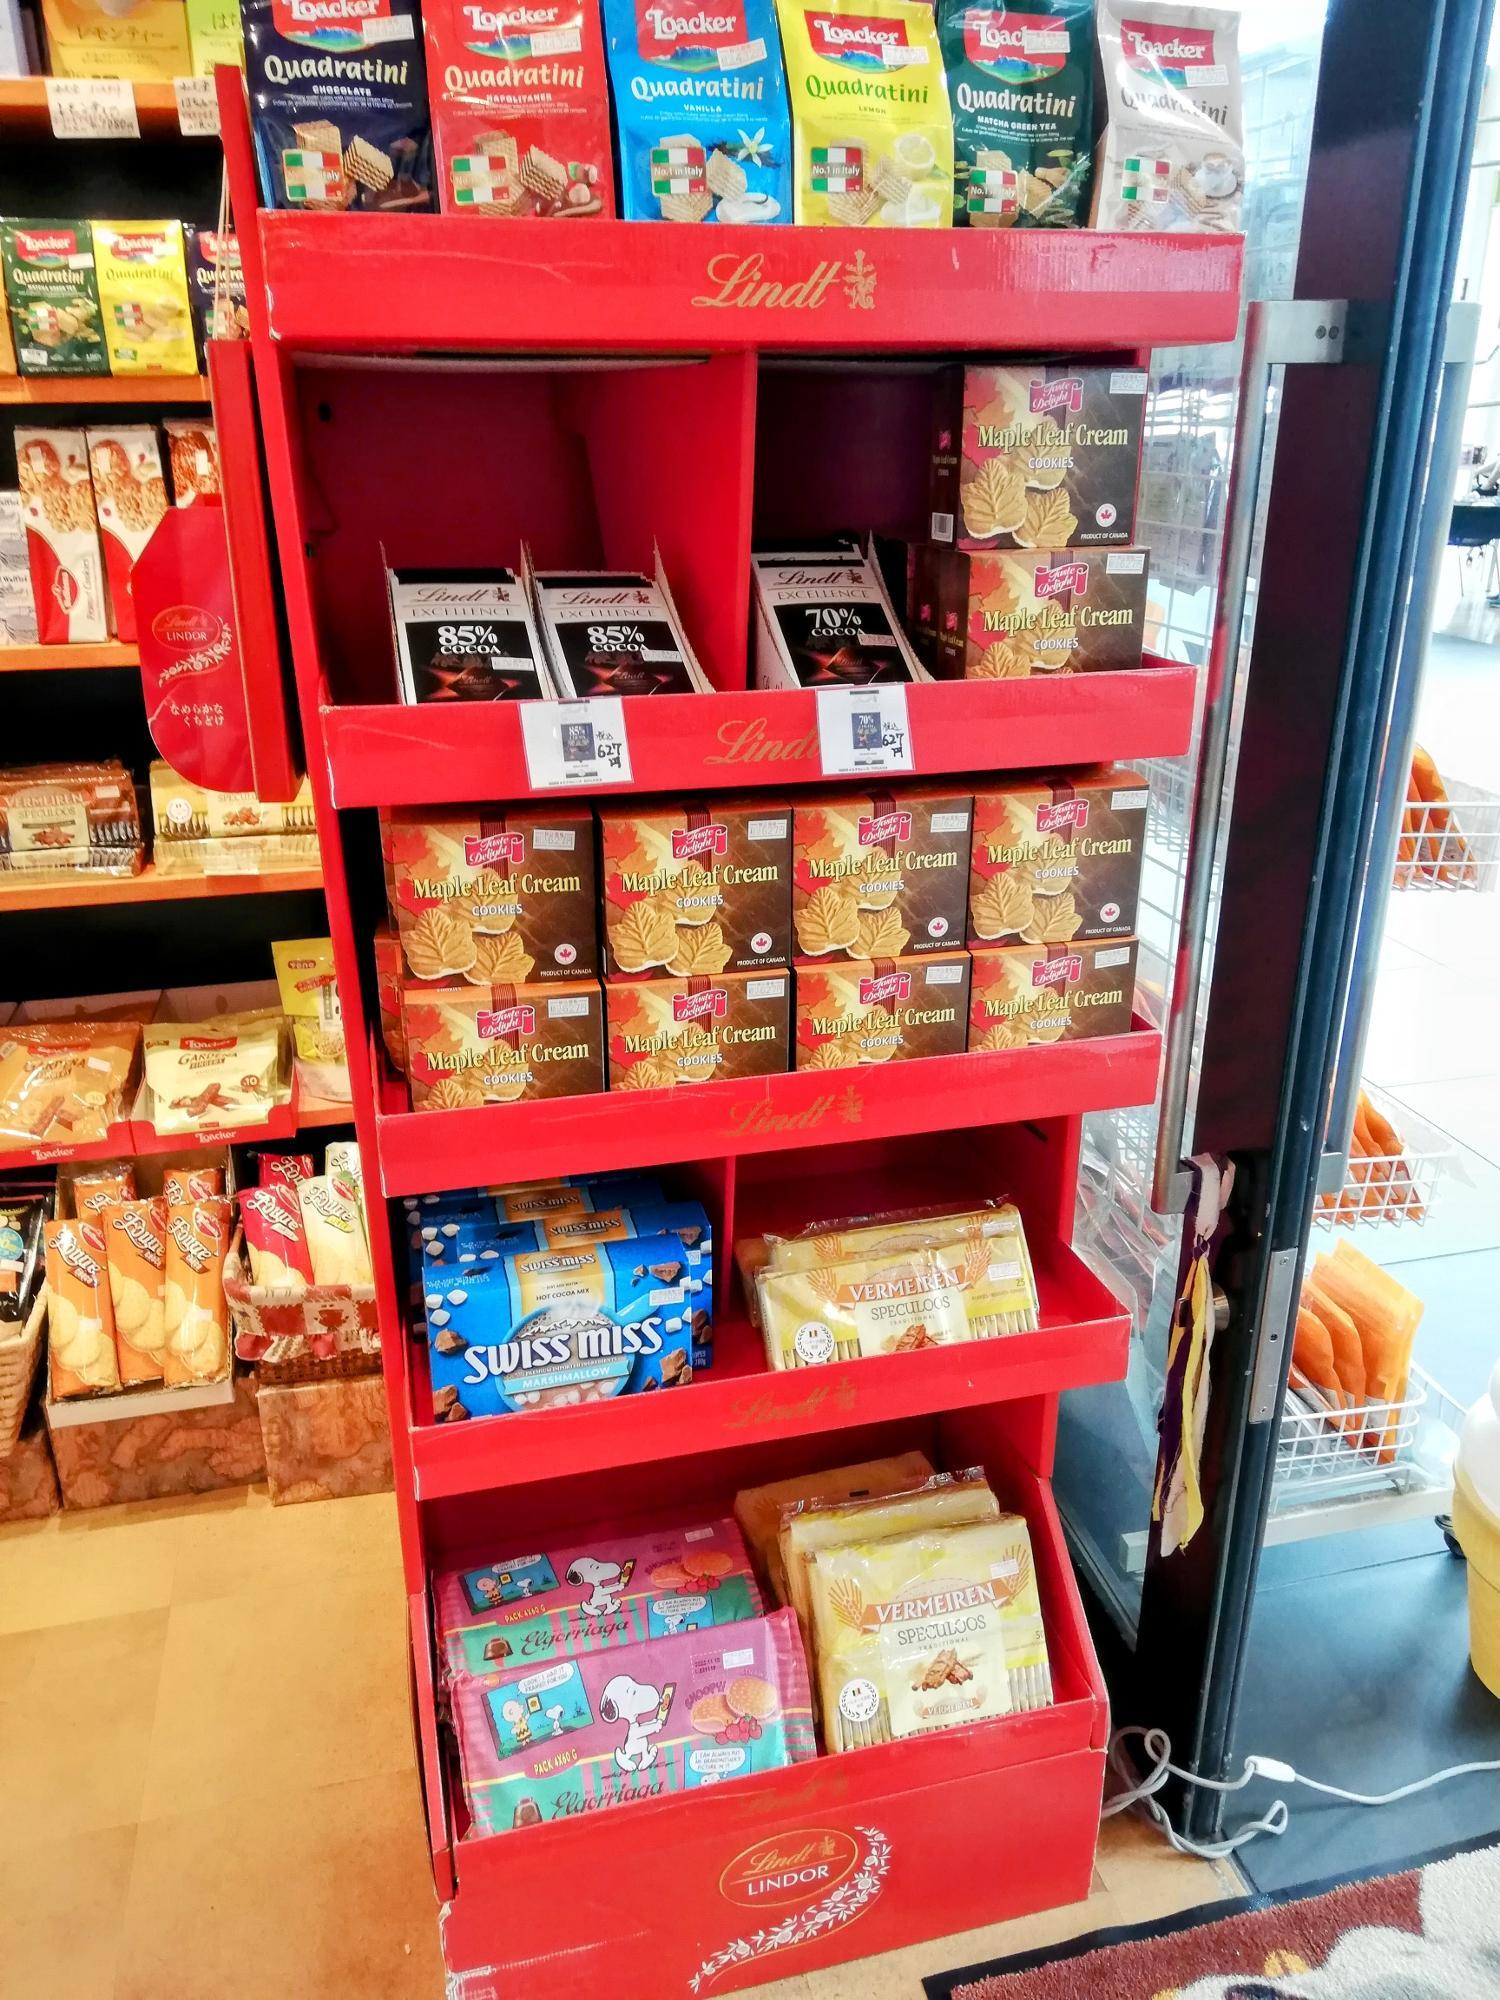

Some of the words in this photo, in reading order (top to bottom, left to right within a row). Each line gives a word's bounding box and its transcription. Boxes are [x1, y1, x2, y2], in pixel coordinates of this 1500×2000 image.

[291, 0, 379, 22] Loacker
[463, 5, 559, 32] Loacker
[645, 7, 737, 40] Loacker
[814, 19, 900, 46] Loacker
[1128, 31, 1207, 60] Loacker
[263, 55, 409, 86] Quadratini
[444, 64, 585, 93] Quadratini
[311, 84, 372, 97] CHOCOLATE
[630, 76, 765, 102] Quadratini
[805, 74, 930, 105] Quadratini
[683, 103, 723, 114] VANILLA
[956, 82, 1077, 119] Quadratini
[977, 115, 1010, 129] MATCHA
[1010, 122, 1038, 131] GREEN
[1040, 122, 1057, 131] TEA
[684, 165, 704, 178] Italy
[842, 164, 861, 179] Italy
[12, 267, 85, 286] Quadratini
[691, 252, 842, 310] Lindt
[1032, 391, 1070, 412] Delight
[978, 424, 1033, 453] Maple
[1035, 423, 1074, 447] Leaf
[1076, 425, 1129, 446] Cream
[1028, 456, 1074, 469] COOKIES
[1109, 532, 1129, 540] CANADA
[774, 570, 844, 586] Lindt
[1037, 577, 1074, 597] Delight
[411, 586, 490, 604] Lindt
[556, 590, 631, 606] Lindt
[777, 589, 869, 600] EXCELLENCE
[411, 607, 512, 618] EXCELLENCE
[560, 608, 654, 618] EXCELLENCE
[805, 608, 862, 629] 70%
[983, 610, 1036, 637] Maple
[1039, 609, 1078, 630] Leaf
[1080, 607, 1134, 626] Cream
[167, 631, 208, 641] LINDOR
[438, 625, 499, 647] 85%
[587, 625, 645, 647] 85%
[811, 628, 866, 637] COCOA
[440, 644, 502, 655] COCOA
[592, 643, 649, 653] COCOA
[1033, 637, 1079, 651] COOKIES
[170, 702, 224, 716] なめらかな
[184, 715, 225, 729] くちどけ
[882, 733, 905, 747] 627
[597, 743, 622, 759] 627
[891, 746, 904, 758] 円
[1039, 811, 1077, 830] Delight
[860, 823, 899, 843] Delight
[468, 845, 511, 864] Delight
[674, 838, 715, 857] Delight
[986, 843, 1039, 868] Maple
[1042, 841, 1079, 860] Leaf
[1081, 837, 1132, 857] Cream
[809, 857, 862, 884] Maple
[865, 854, 902, 876] Leaf
[905, 850, 958, 871] Cream
[1034, 866, 1080, 879] COOKIES
[413, 875, 472, 904] Maple
[477, 873, 519, 897] Leaf
[521, 873, 581, 894] Cream
[621, 869, 678, 897] Maple
[681, 866, 720, 888] Leaf
[724, 864, 779, 885] Cream
[858, 878, 905, 893] COOKIES
[472, 902, 523, 917] COOKIES
[675, 893, 724, 909] COOKIES
[1112, 925, 1132, 933] CANADA
[913, 942, 933, 950] PRODUCT
[736, 959, 758, 967] PRODUCT
[766, 956, 786, 965] CANADA
[570, 968, 592, 976] CANADA
[1034, 967, 1072, 985] Delight
[861, 985, 900, 1003] Delight
[675, 1003, 715, 1020] Delight
[984, 996, 1035, 1021] Maple
[1037, 993, 1073, 1012] Leaf
[1074, 988, 1124, 1007] Cream
[479, 1020, 520, 1038] Delight
[811, 1016, 863, 1040] Maple
[866, 1013, 902, 1032] Leaf
[904, 1007, 956, 1027] Cream
[1029, 1015, 1073, 1030] COOKIES
[624, 1031, 678, 1058] Maple
[681, 1029, 720, 1049] Leaf
[722, 1024, 777, 1046] Cream
[859, 1034, 904, 1048] COOKIES
[426, 1048, 484, 1076] Maple
[487, 1045, 528, 1067] Leaf
[531, 1042, 590, 1063] Cream
[676, 1052, 724, 1068] COOKIES
[483, 1071, 534, 1086] COOKIES
[719, 1095, 834, 1137] Lindt
[196, 1129, 238, 1144] Loacker
[31, 1147, 75, 1161] Loacker
[551, 1222, 587, 1236] SWISS
[588, 1218, 621, 1231] MISS
[520, 1259, 560, 1274] SWISS
[562, 1253, 596, 1266] MISS
[536, 1293, 551, 1302] HOT
[552, 1290, 576, 1299] COCOA
[577, 1288, 590, 1296] MIX
[848, 1272, 960, 1302] VERMEIREN
[871, 1295, 951, 1321] SPECULOOS
[463, 1333, 572, 1385] SWISS
[577, 1316, 664, 1360] MISS
[522, 1366, 611, 1389] MARSHMALLOW
[875, 1582, 996, 1623] VERMEIREN
[504, 1613, 522, 1624] PACK
[540, 1604, 546, 1613] G
[521, 1620, 629, 1656] Elgorriaga
[897, 1614, 987, 1647] SPECULOOS
[534, 1761, 553, 1776] PACK
[570, 1750, 577, 1761] G
[742, 1842, 817, 1876] Lindt
[748, 1864, 830, 1897] LINDOR
